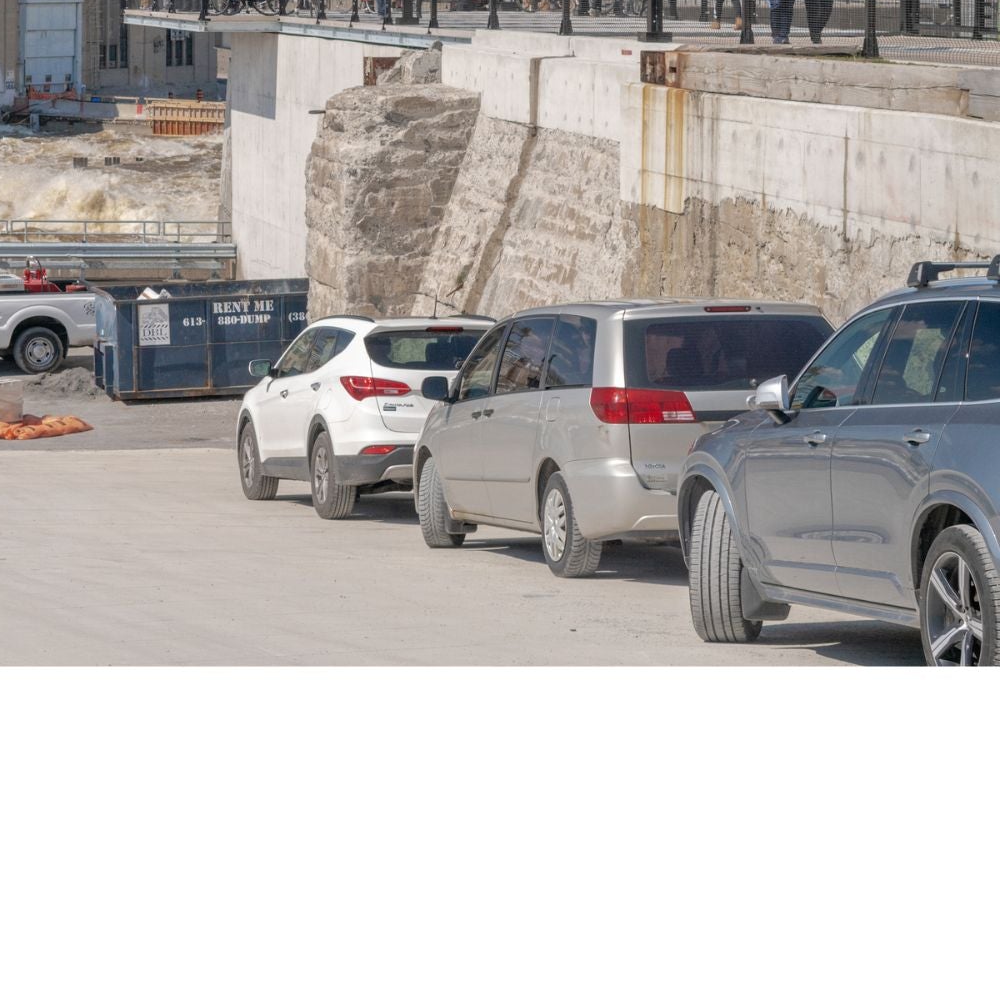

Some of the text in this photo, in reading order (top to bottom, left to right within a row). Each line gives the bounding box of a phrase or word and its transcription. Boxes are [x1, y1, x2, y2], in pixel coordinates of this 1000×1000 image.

[212, 299, 274, 314] RENT ME
[182, 311, 306, 327] 613- 880-DUMP (38
